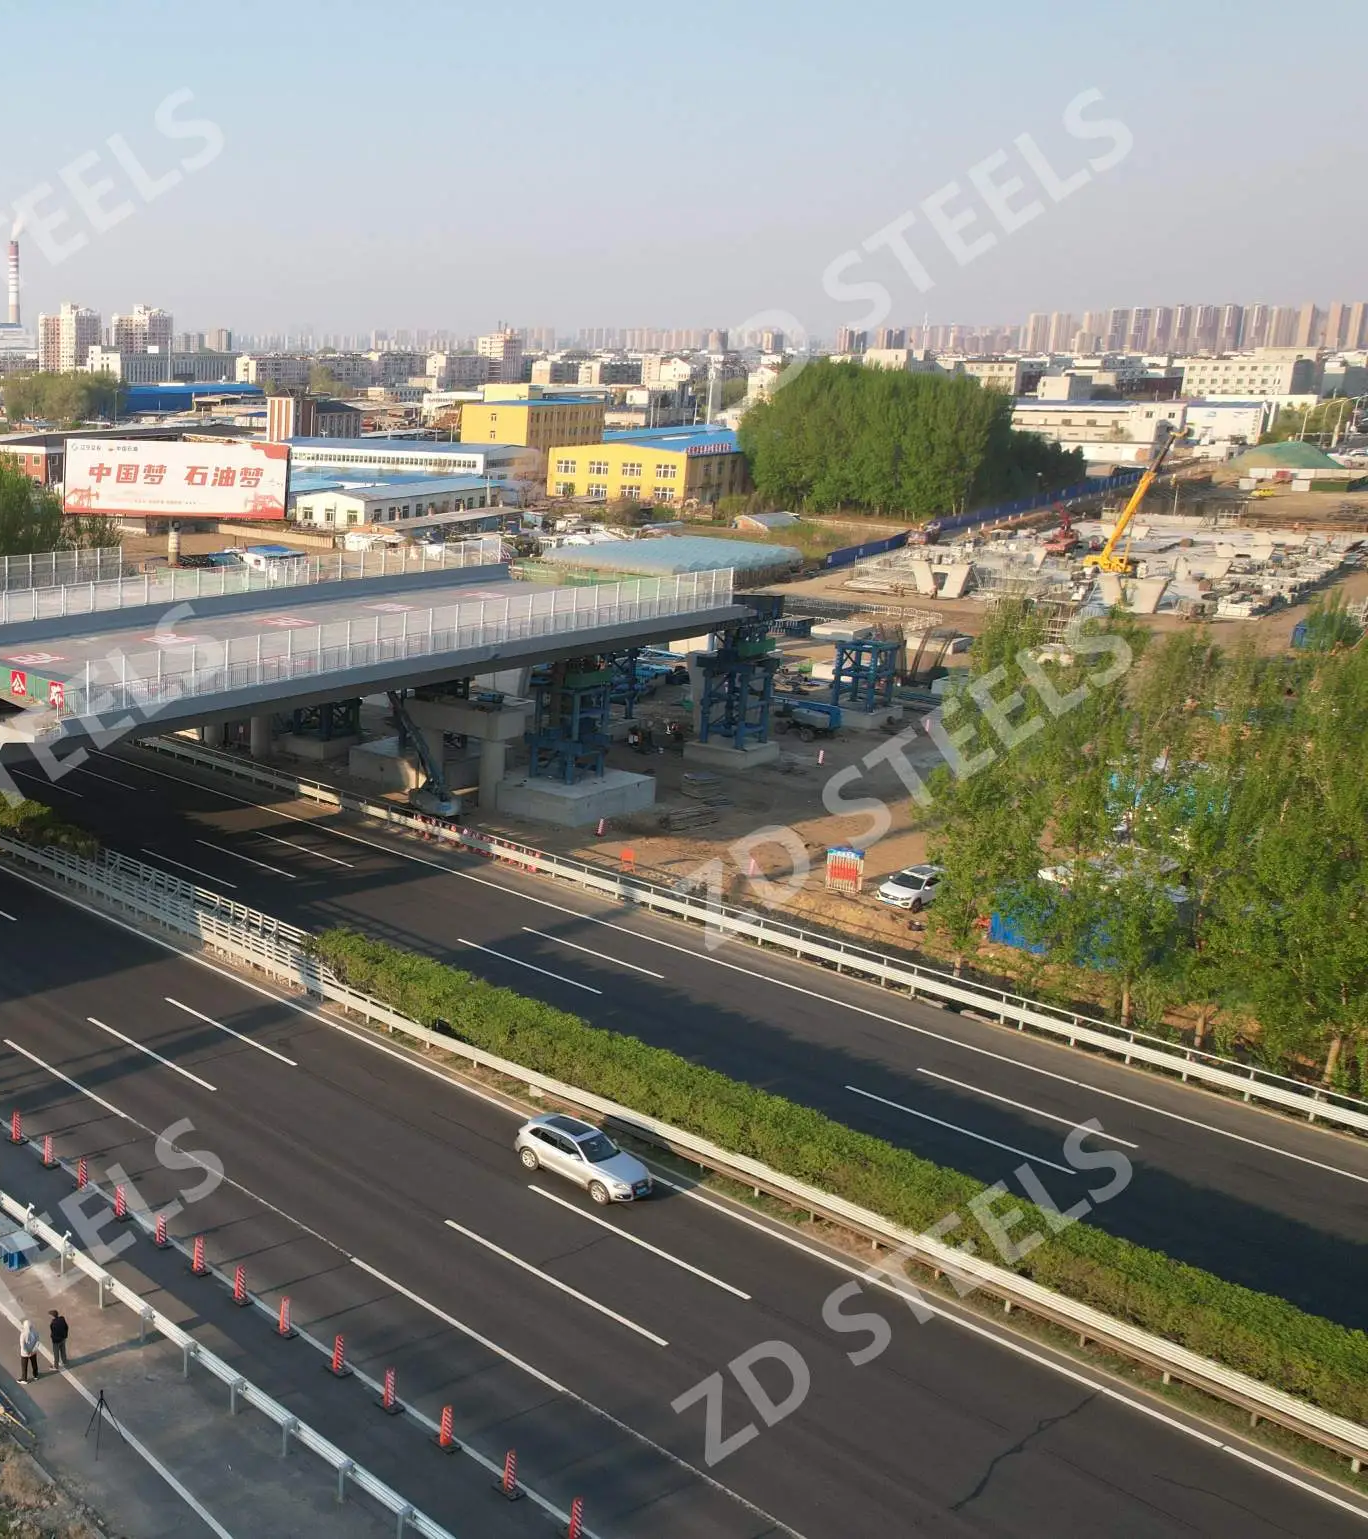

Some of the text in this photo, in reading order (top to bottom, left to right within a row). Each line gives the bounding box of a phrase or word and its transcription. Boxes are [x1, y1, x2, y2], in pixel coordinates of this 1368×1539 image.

[88, 462, 264, 488] 中国梦 石油梦
